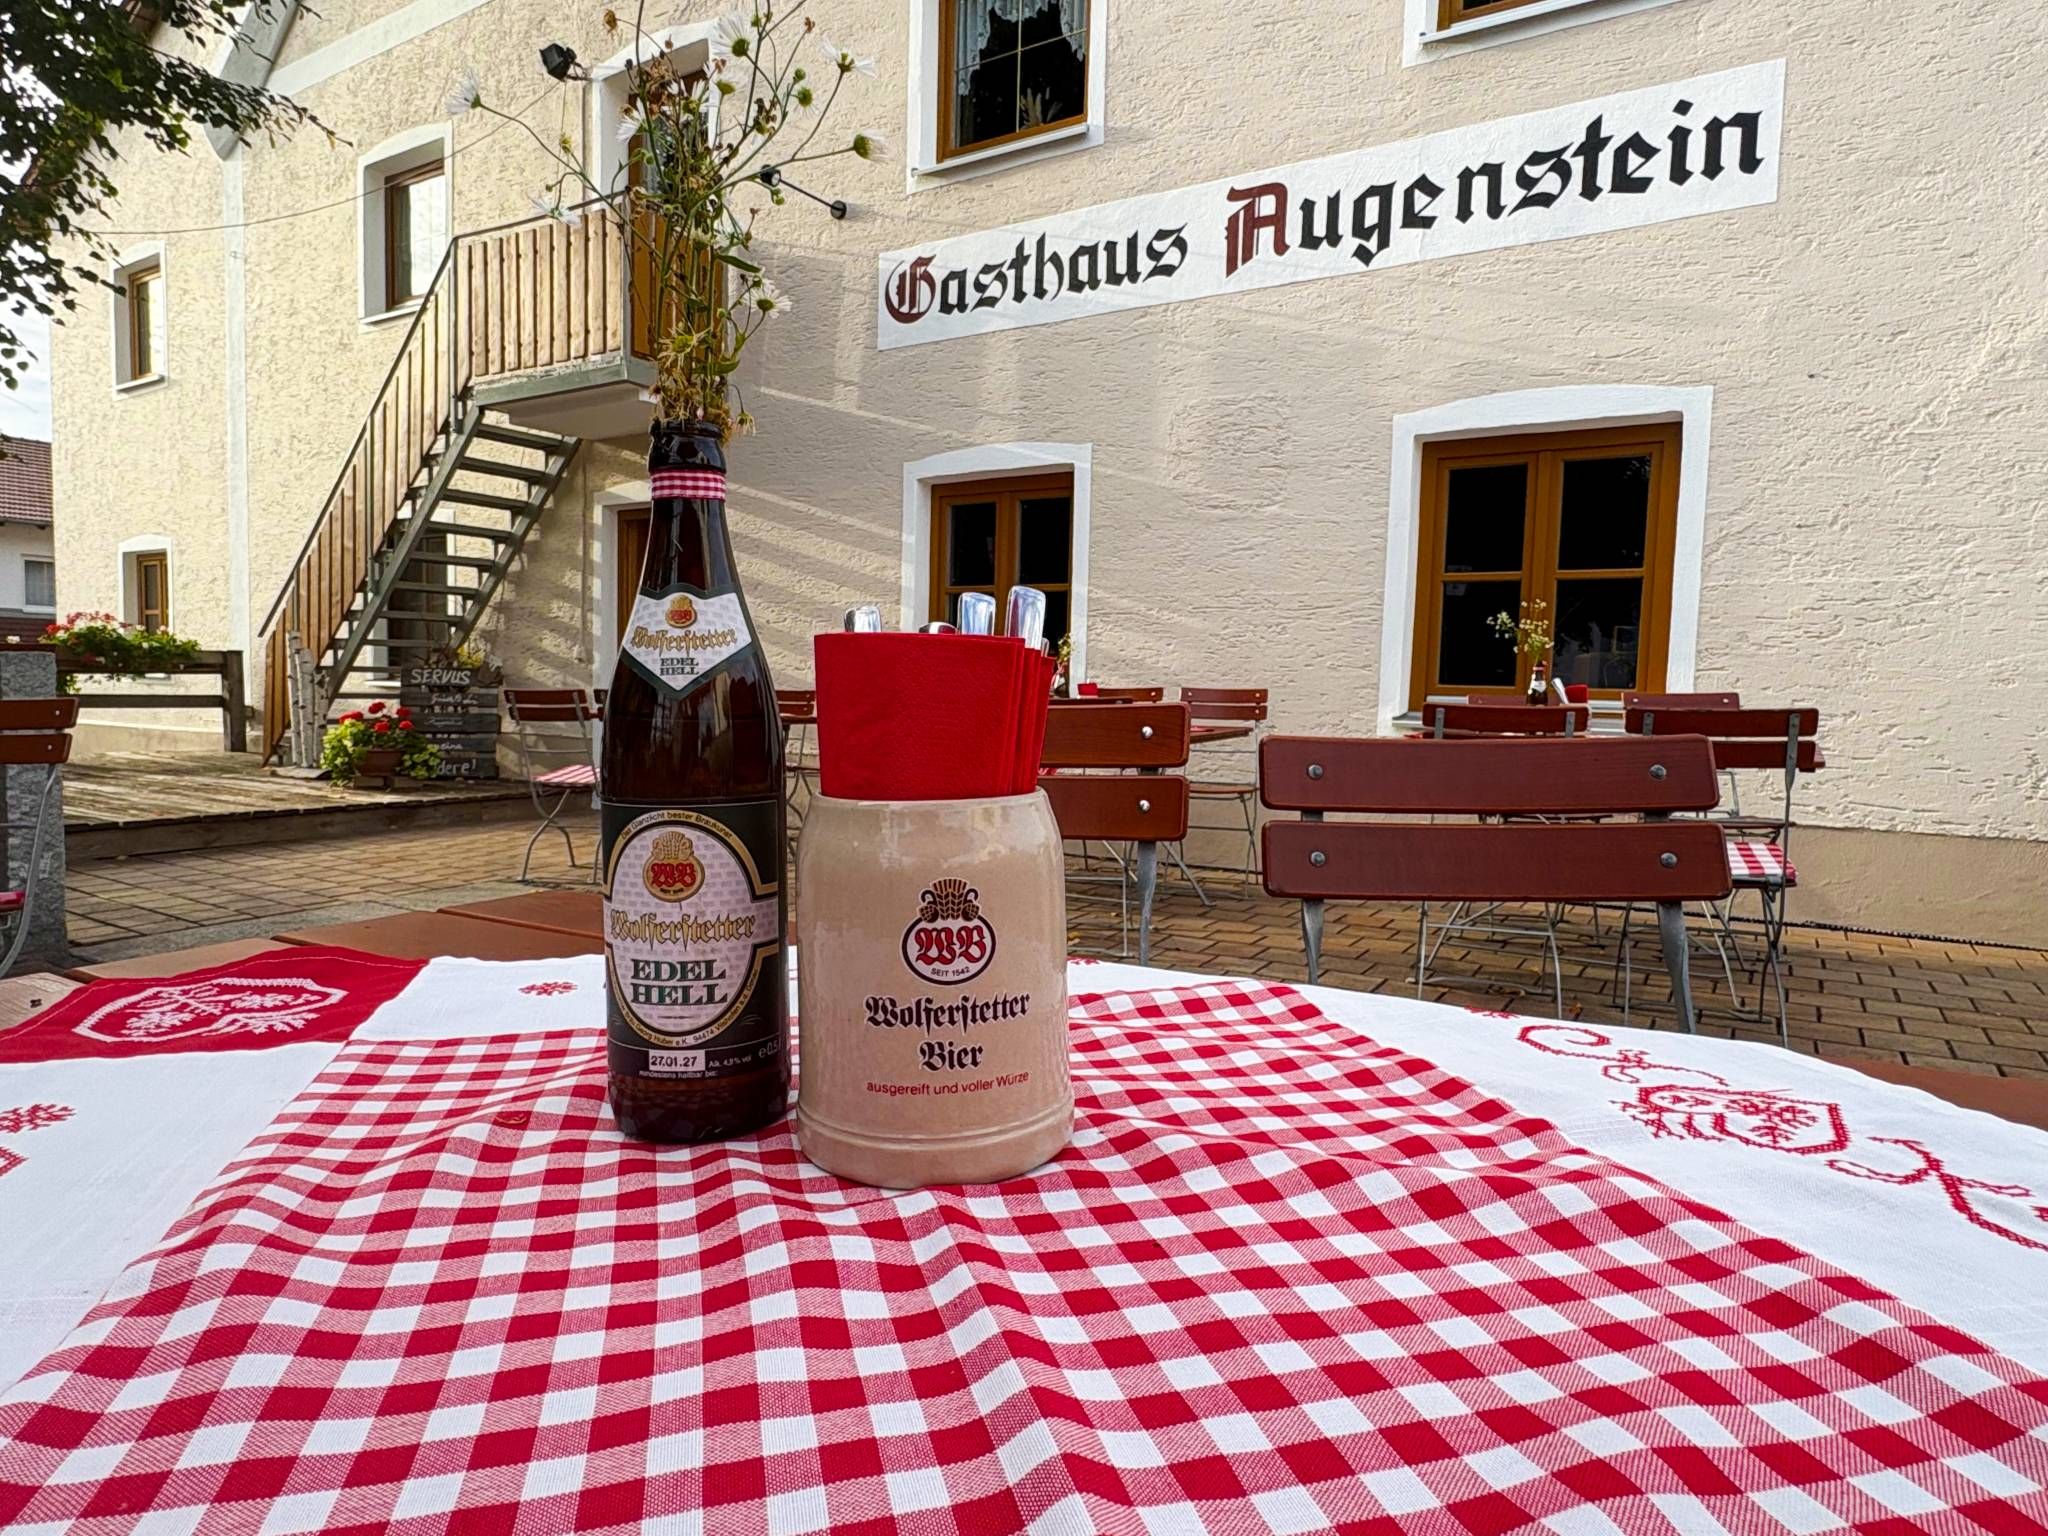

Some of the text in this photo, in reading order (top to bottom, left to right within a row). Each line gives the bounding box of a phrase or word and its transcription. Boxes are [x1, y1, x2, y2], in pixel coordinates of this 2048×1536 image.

[885, 98, 1764, 324] Gasthaus Augenstein
[660, 658, 700, 667] EDEL
[411, 668, 471, 685] SERVUS
[660, 667, 700, 676] HELL
[666, 811, 694, 821] bester
[914, 924, 987, 966] WB
[630, 958, 727, 983] EDEL
[930, 966, 970, 977] SEIT 1542
[630, 982, 728, 1006] HELL
[692, 1028, 715, 1043] 94474
[650, 1055, 698, 1068] 27.01.27
[919, 1041, 984, 1072] Bier
[866, 1081, 931, 1096] ausgereift
[933, 1082, 959, 1096] und
[961, 1079, 993, 1093] voller
